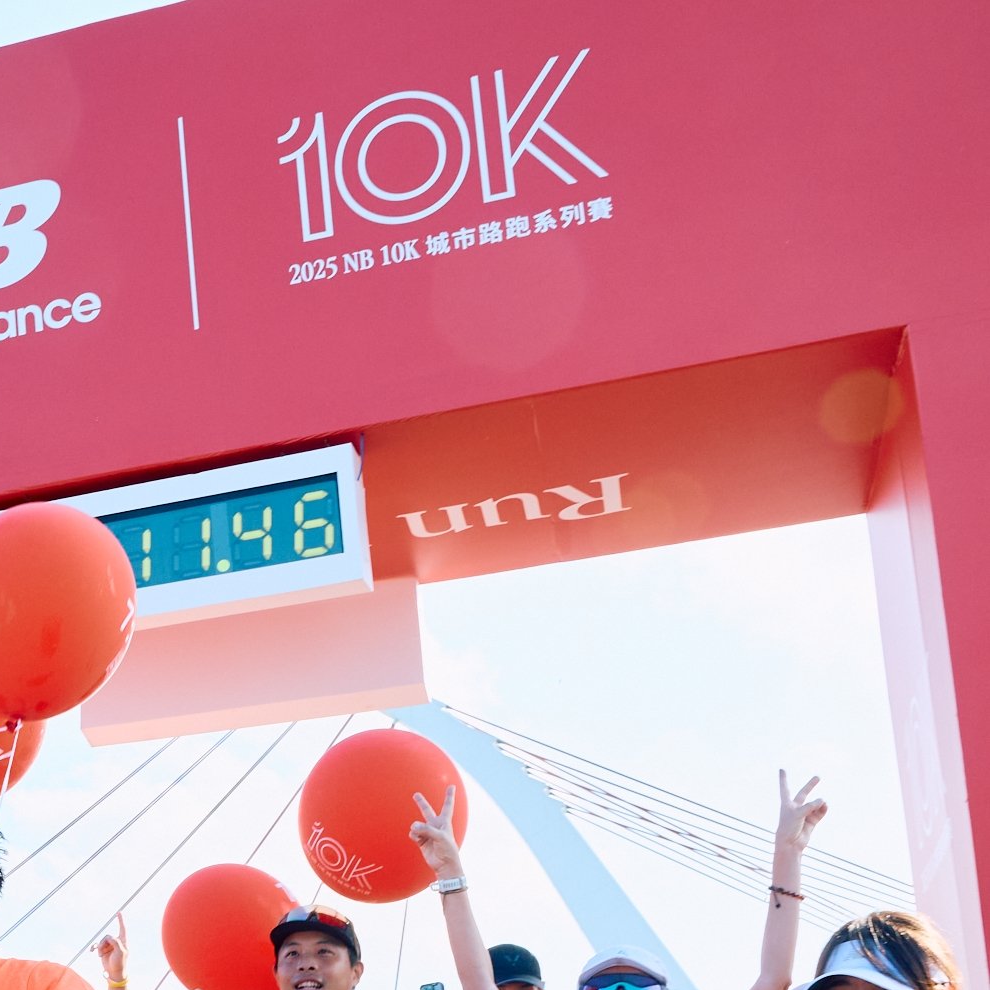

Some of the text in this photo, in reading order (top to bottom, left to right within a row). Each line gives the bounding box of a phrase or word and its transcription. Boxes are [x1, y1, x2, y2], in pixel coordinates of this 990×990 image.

[276, 48, 610, 242] 10K
[288, 196, 614, 285] 2025 NB 10K 城市路跑系列賽
[396, 472, 633, 539] Run
[306, 820, 384, 891] 10K
